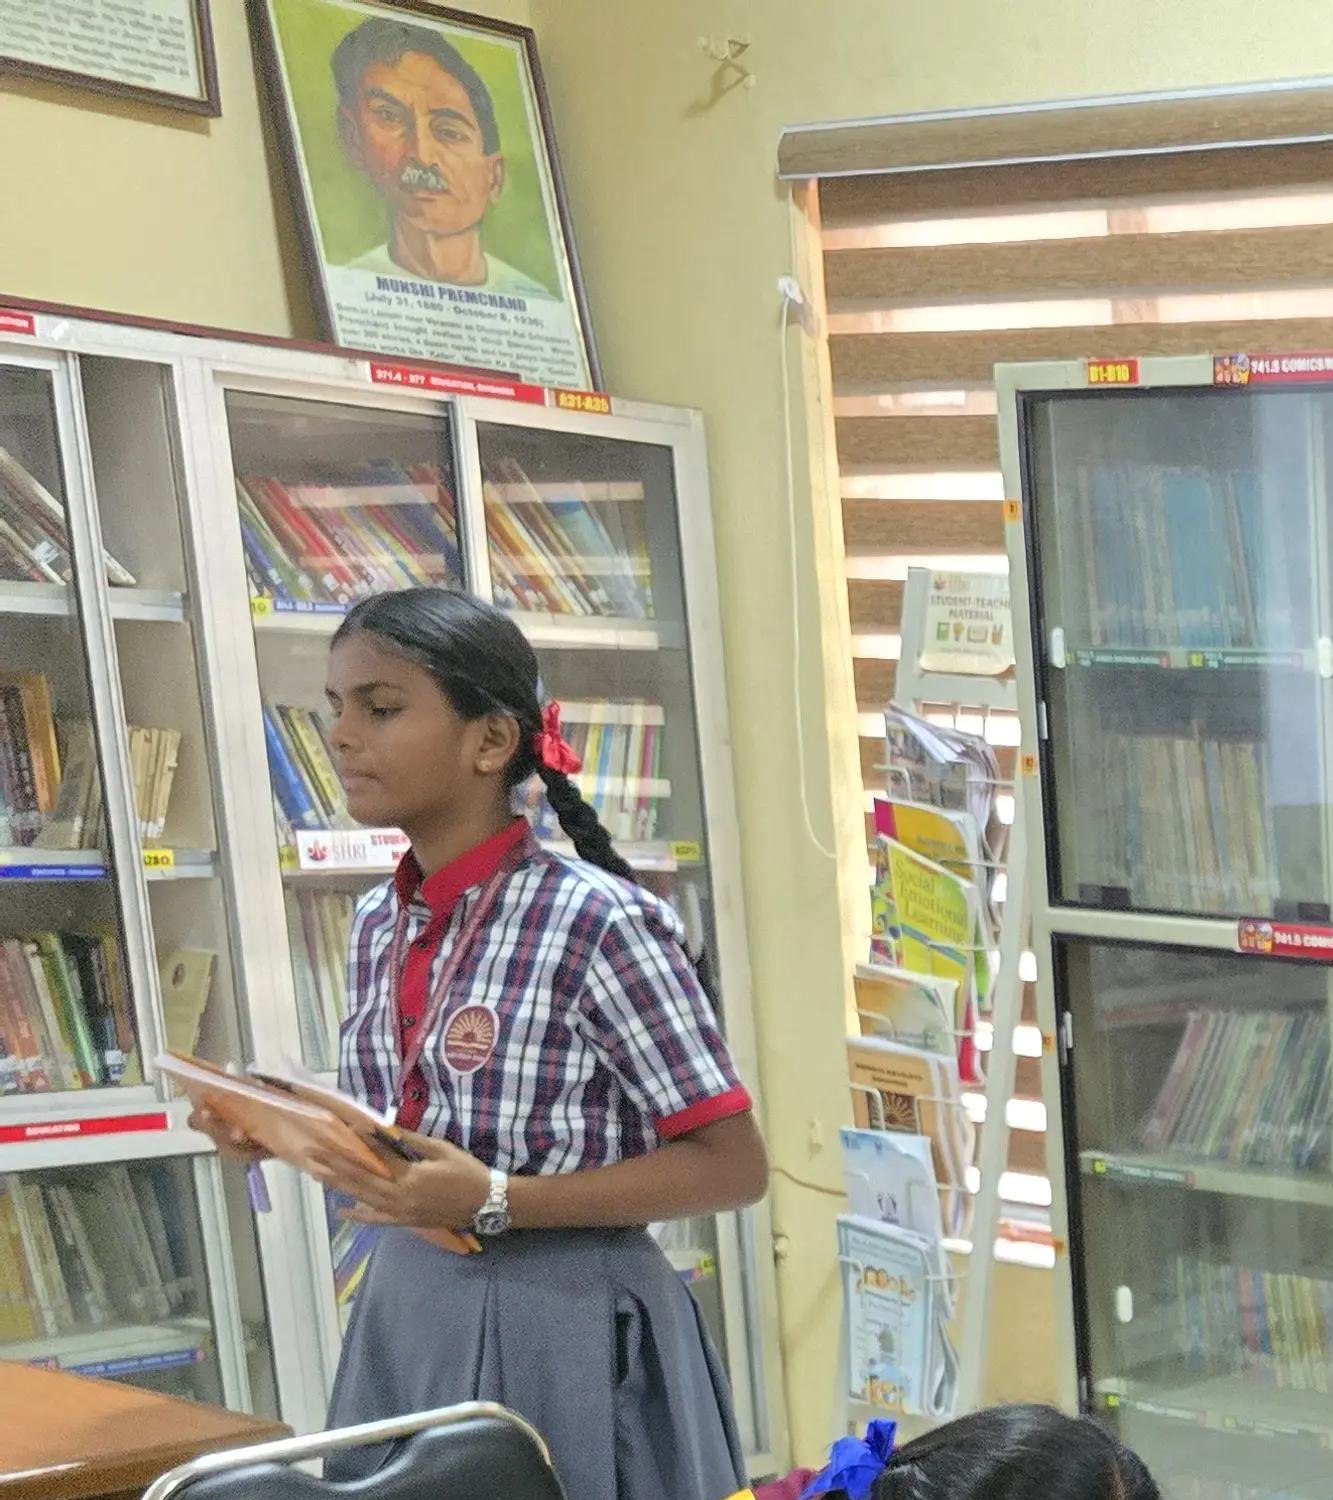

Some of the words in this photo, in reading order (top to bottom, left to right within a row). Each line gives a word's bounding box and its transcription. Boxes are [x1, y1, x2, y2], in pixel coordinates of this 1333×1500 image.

[376, 275, 435, 298] MUNSHI
[438, 285, 528, 312] PREMCHAND
[896, 858, 934, 892] Social
[902, 882, 968, 931] Emotional
